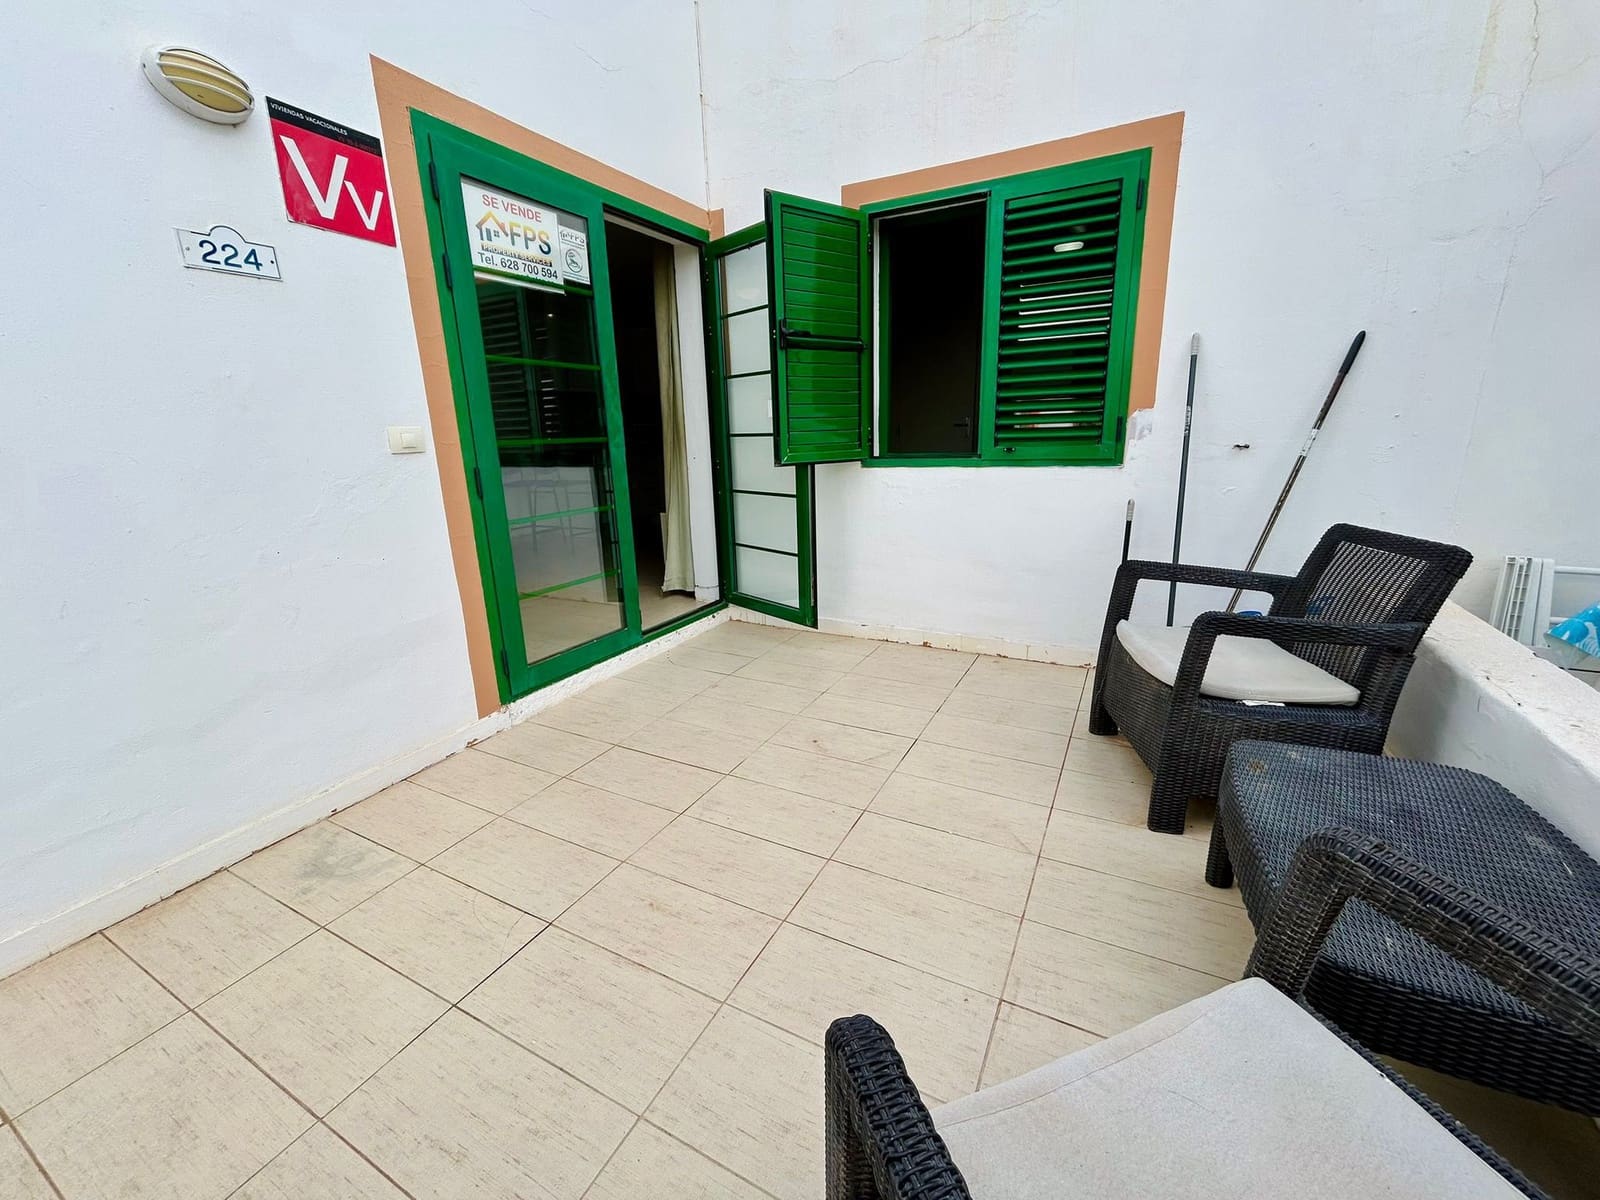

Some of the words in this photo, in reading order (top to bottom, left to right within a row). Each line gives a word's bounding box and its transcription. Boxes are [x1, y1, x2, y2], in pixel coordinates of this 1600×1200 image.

[270, 102, 304, 119] VIVIENDAS
[304, 115, 348, 136] VACACIONALES
[482, 194, 499, 210] SE
[501, 199, 541, 222] VENDE
[508, 221, 551, 255] FPS
[198, 239, 263, 271] 224
[478, 251, 497, 266] Tel.
[500, 257, 519, 271] 628
[521, 262, 539, 275] 700
[541, 267, 558, 280] 594
